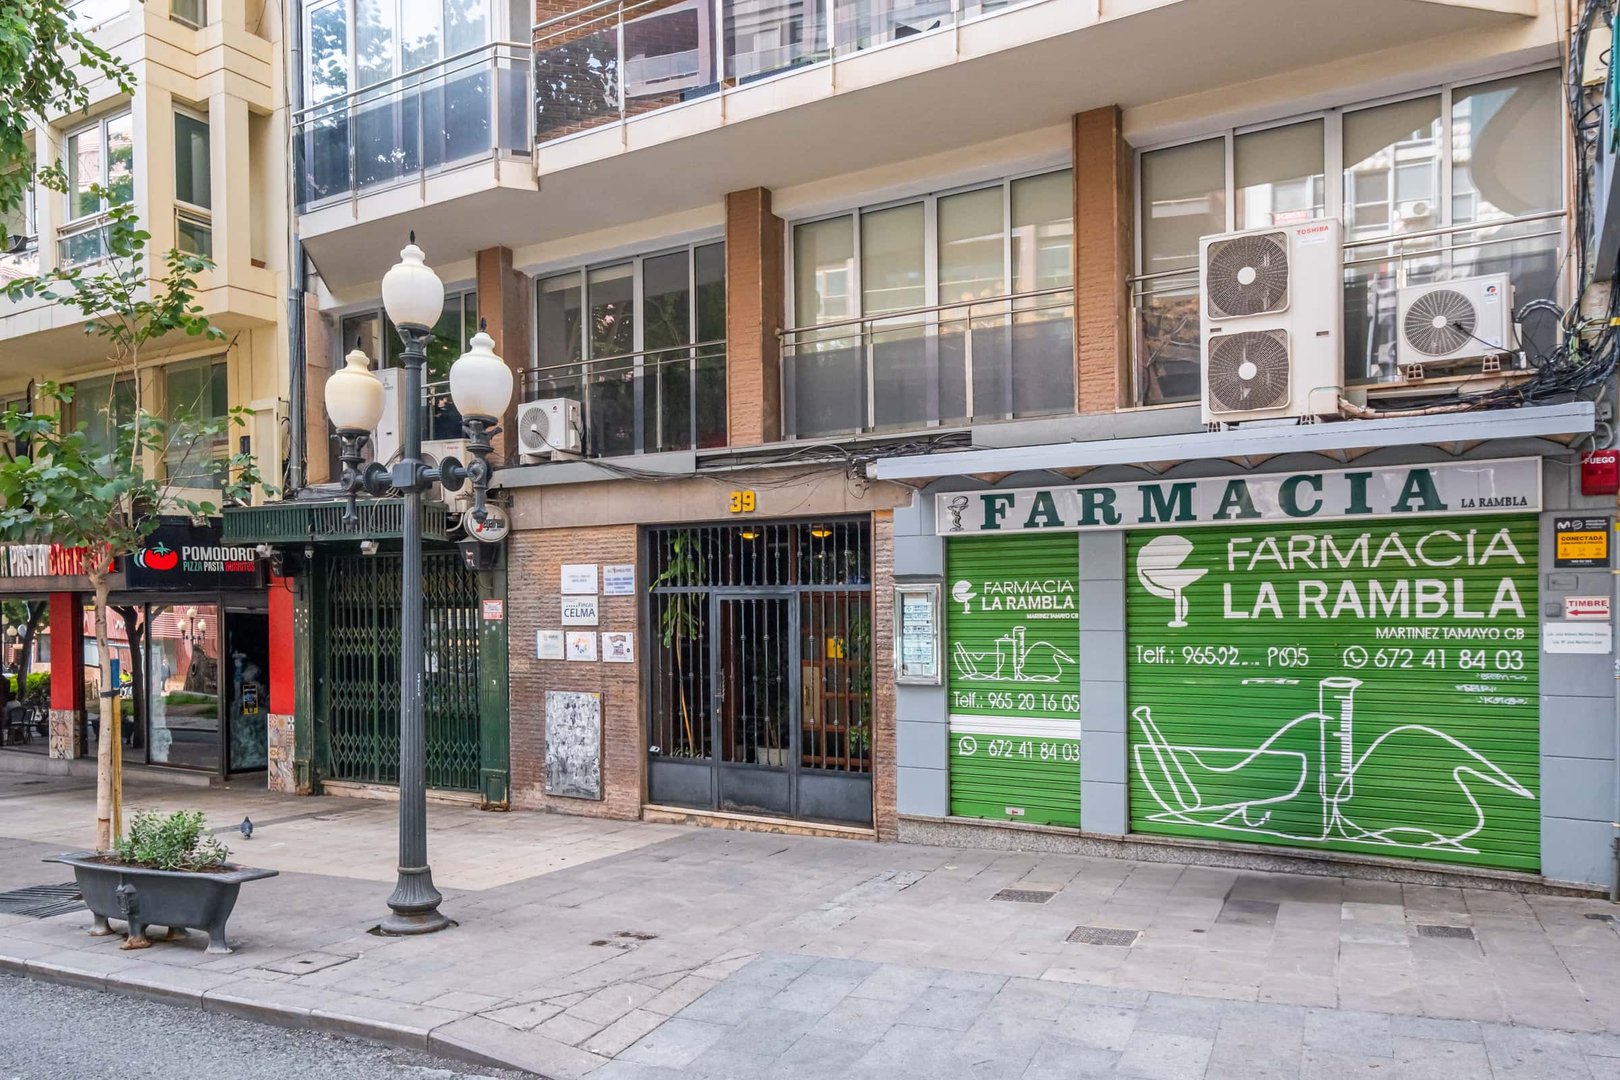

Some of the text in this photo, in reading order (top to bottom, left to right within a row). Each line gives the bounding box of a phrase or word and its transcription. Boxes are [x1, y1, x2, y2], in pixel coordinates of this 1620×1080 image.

[1296, 225, 1329, 235] TOSHIBA
[730, 490, 755, 512] 39
[980, 468, 1447, 530] FARMACIA
[1461, 496, 1528, 508] LA RAMBLA
[182, 546, 255, 561] POMODORO
[1228, 528, 1526, 571] FARMACIA
[9, 544, 48, 577] PASTA
[183, 561, 202, 572] PIZZA
[204, 561, 224, 572] PASTA
[984, 580, 1074, 594] FARMACIA
[982, 595, 1075, 611] LA RAMBLA
[1223, 577, 1526, 619] LA RAMBLA
[564, 608, 596, 618] CELMA
[1375, 627, 1525, 640] MARTINEZ TAMAYO CB
[1136, 645, 1175, 664] Telf.:
[1374, 648, 1524, 670] 672 41 84 03
[953, 691, 1079, 712] Telf.: 965 20 16 05
[988, 739, 1080, 761] 672 41 84 03
